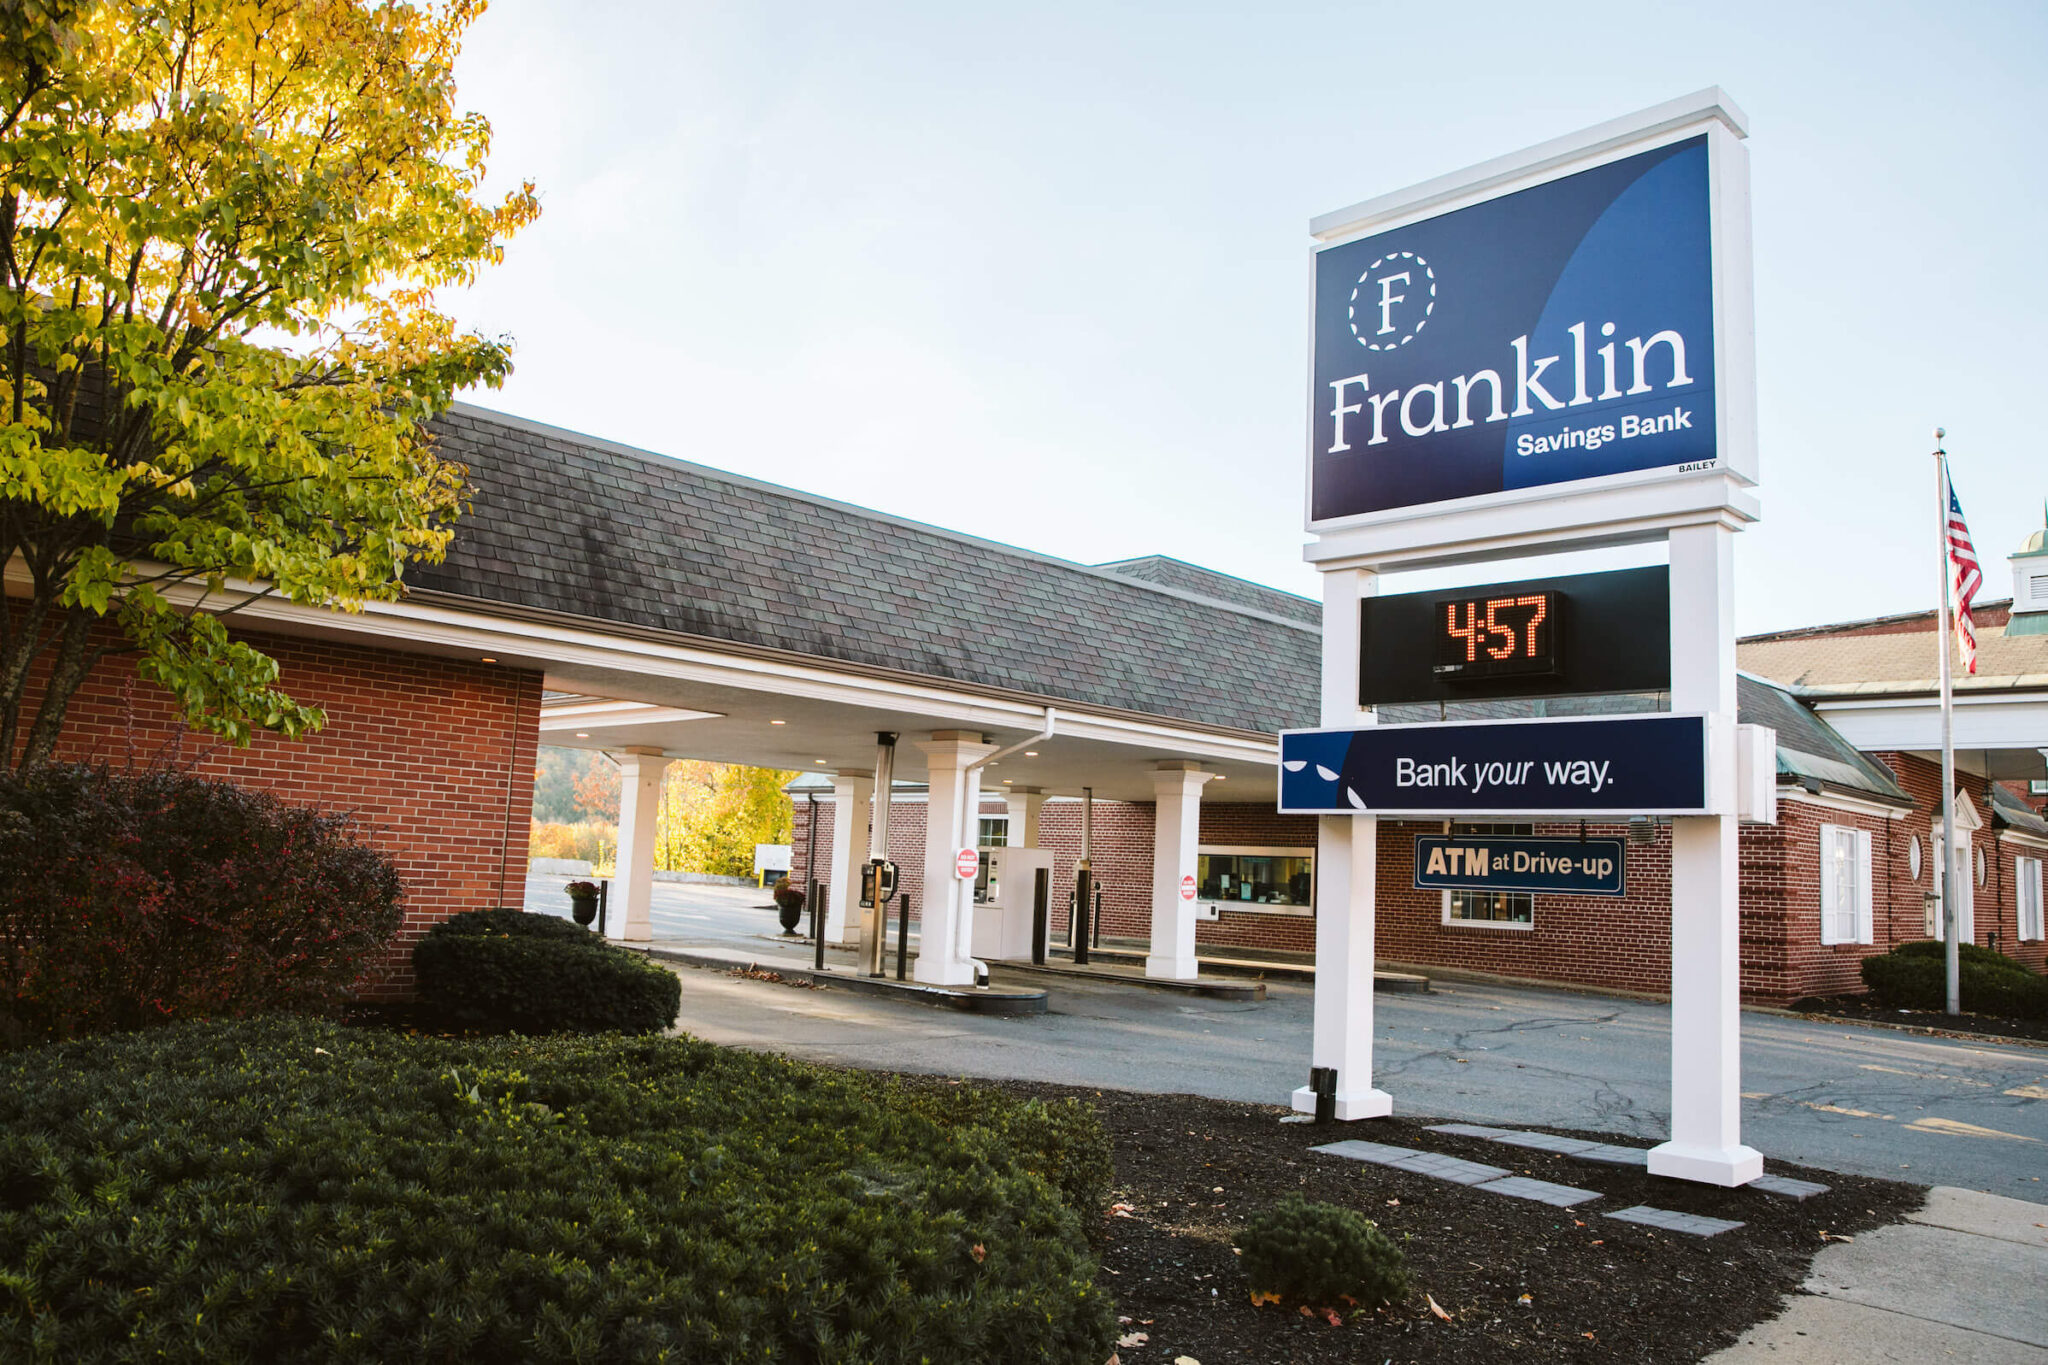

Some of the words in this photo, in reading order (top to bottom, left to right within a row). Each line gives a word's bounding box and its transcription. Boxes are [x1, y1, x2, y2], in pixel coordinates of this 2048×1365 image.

[1376, 271, 1411, 336] F
[1327, 320, 1694, 454] Franklin
[1516, 423, 1615, 457] Savings
[1621, 406, 1692, 440] Bank
[1678, 460, 1716, 473] BAILEY
[1447, 594, 1546, 662] 4:57
[1396, 756, 1468, 788] Bank
[1471, 760, 1534, 794] your
[1544, 759, 1615, 793] way.
[1426, 847, 1489, 877] ATM
[1492, 853, 1510, 872] at
[1513, 850, 1613, 880] Drive-up
